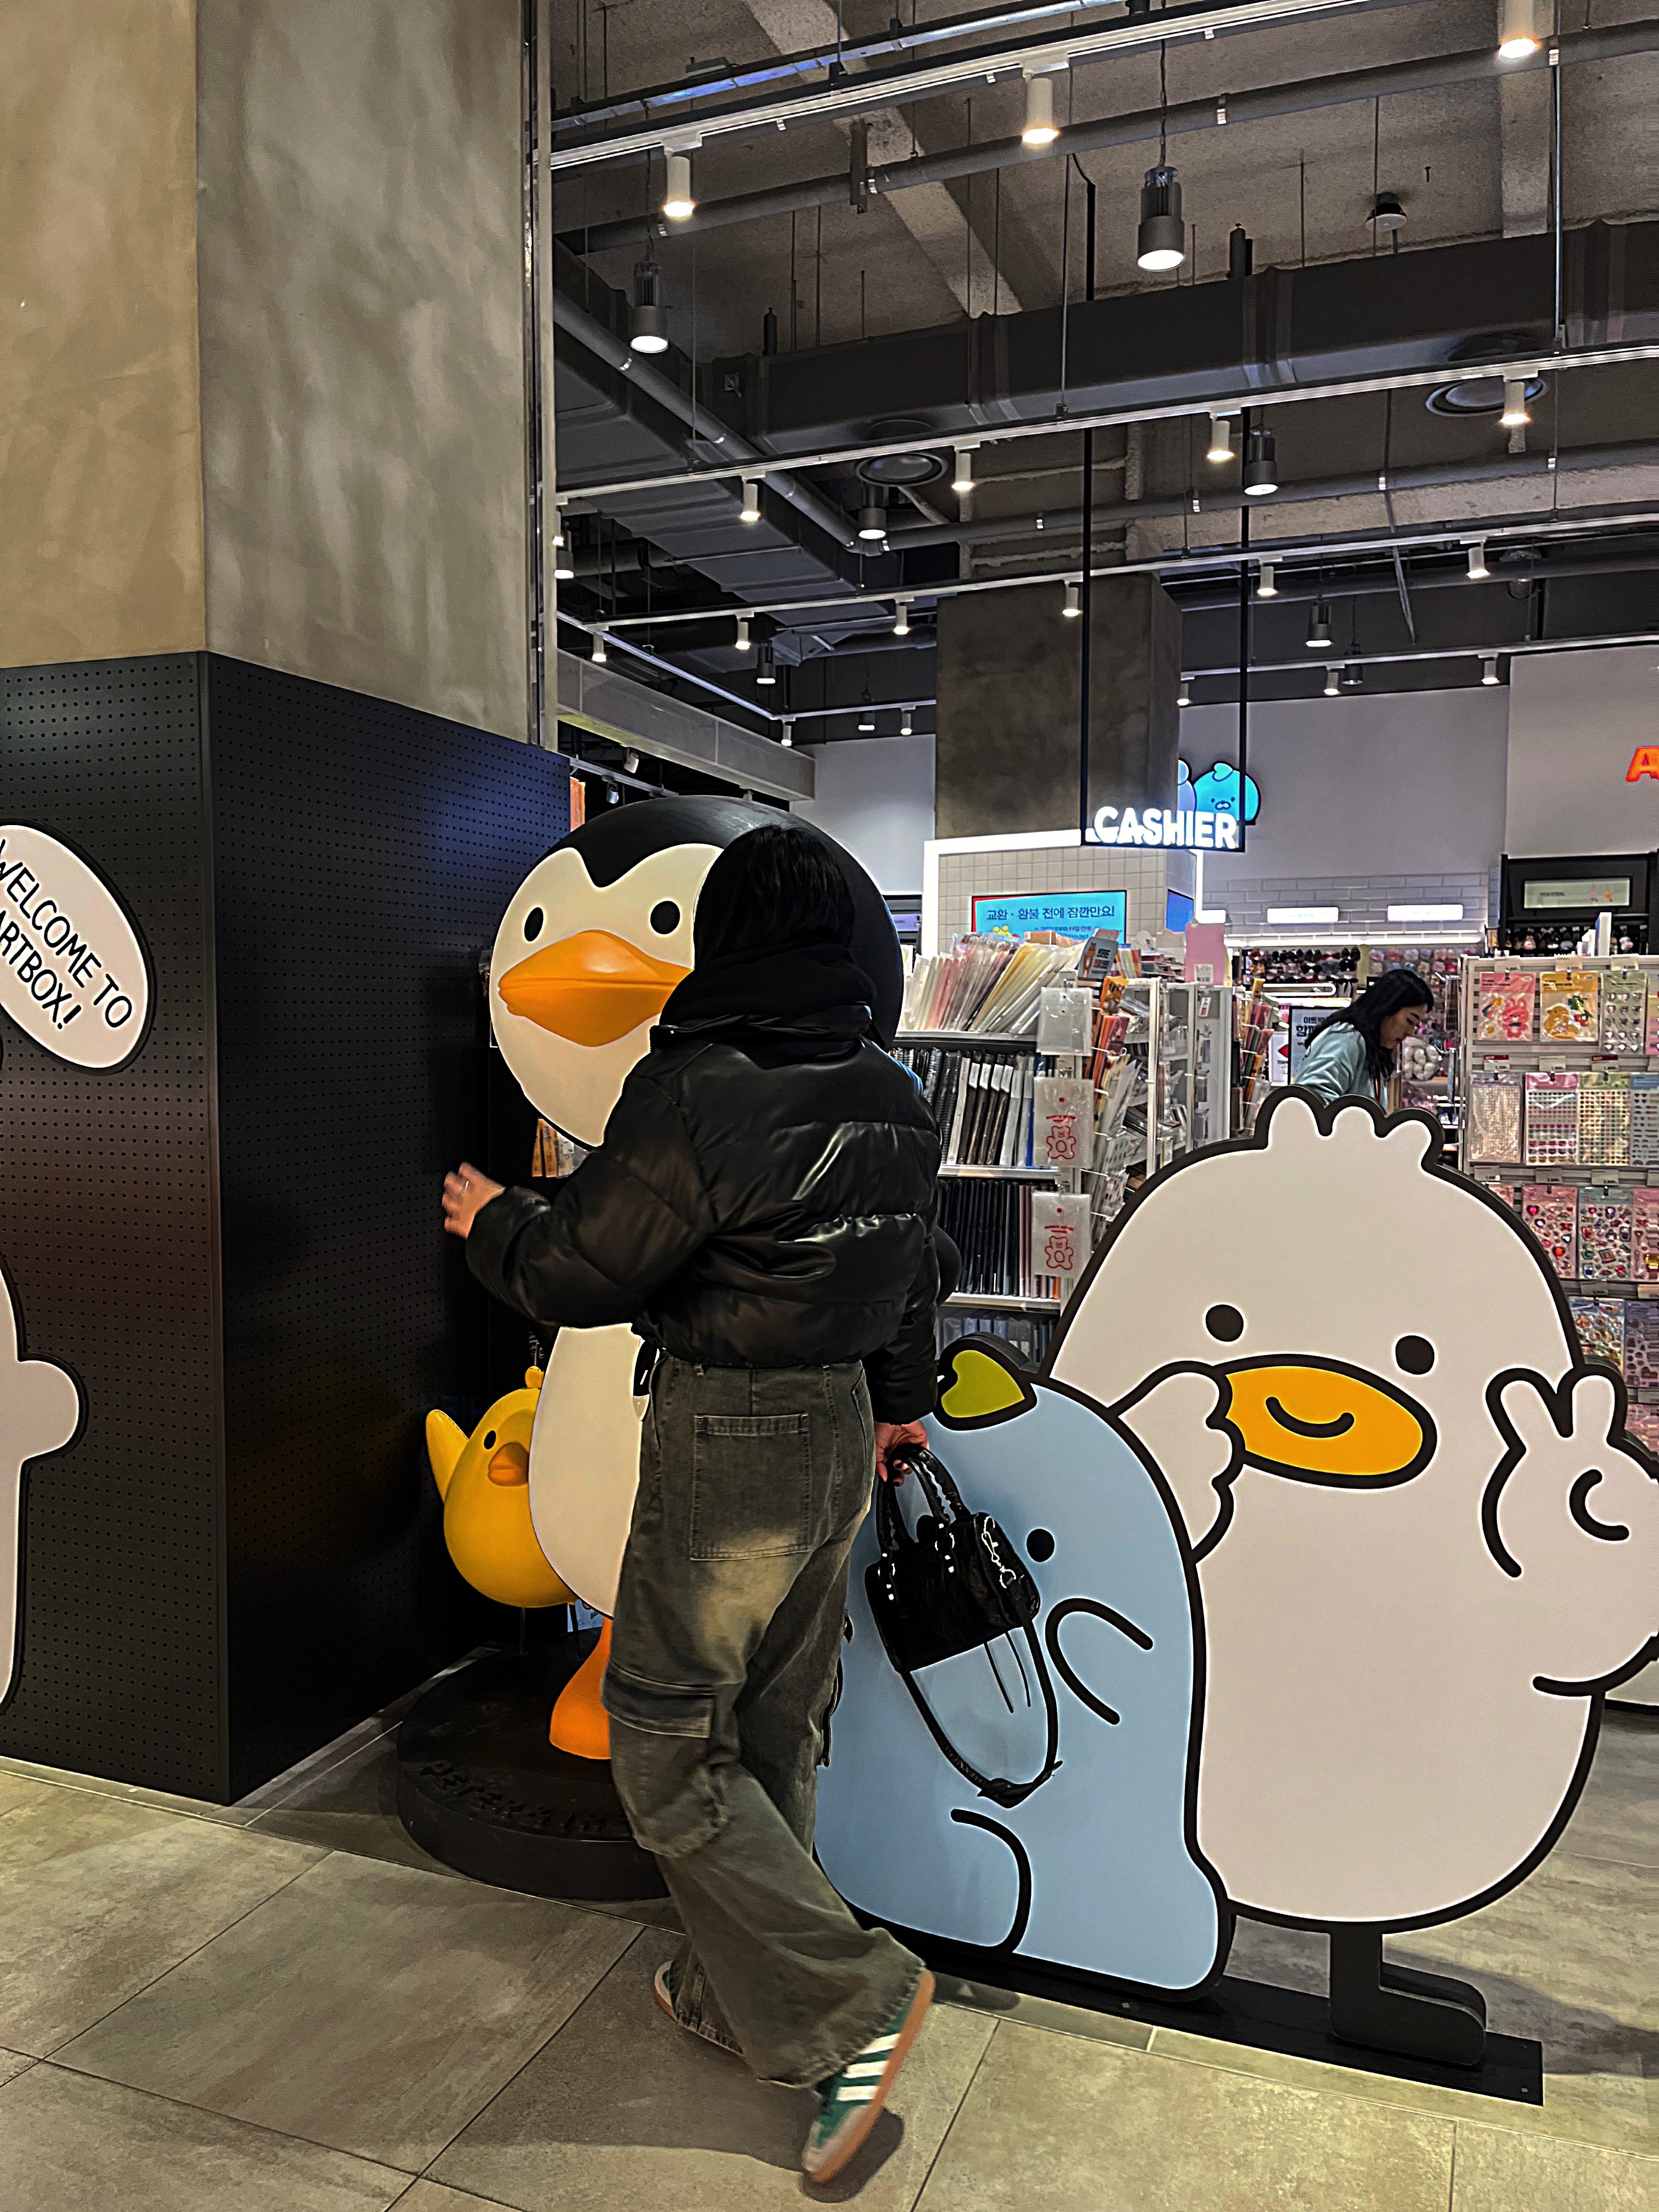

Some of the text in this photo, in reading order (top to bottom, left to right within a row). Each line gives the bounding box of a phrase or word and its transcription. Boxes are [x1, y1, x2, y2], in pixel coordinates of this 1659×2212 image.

[1094, 806, 1238, 849] CASHIER
[987, 909, 1008, 920] 교환
[1018, 908, 1040, 919] 환불
[1042, 907, 1064, 919] 전에
[1068, 905, 1115, 919] 잠깐만요!
[94, 974, 132, 1028] TO
